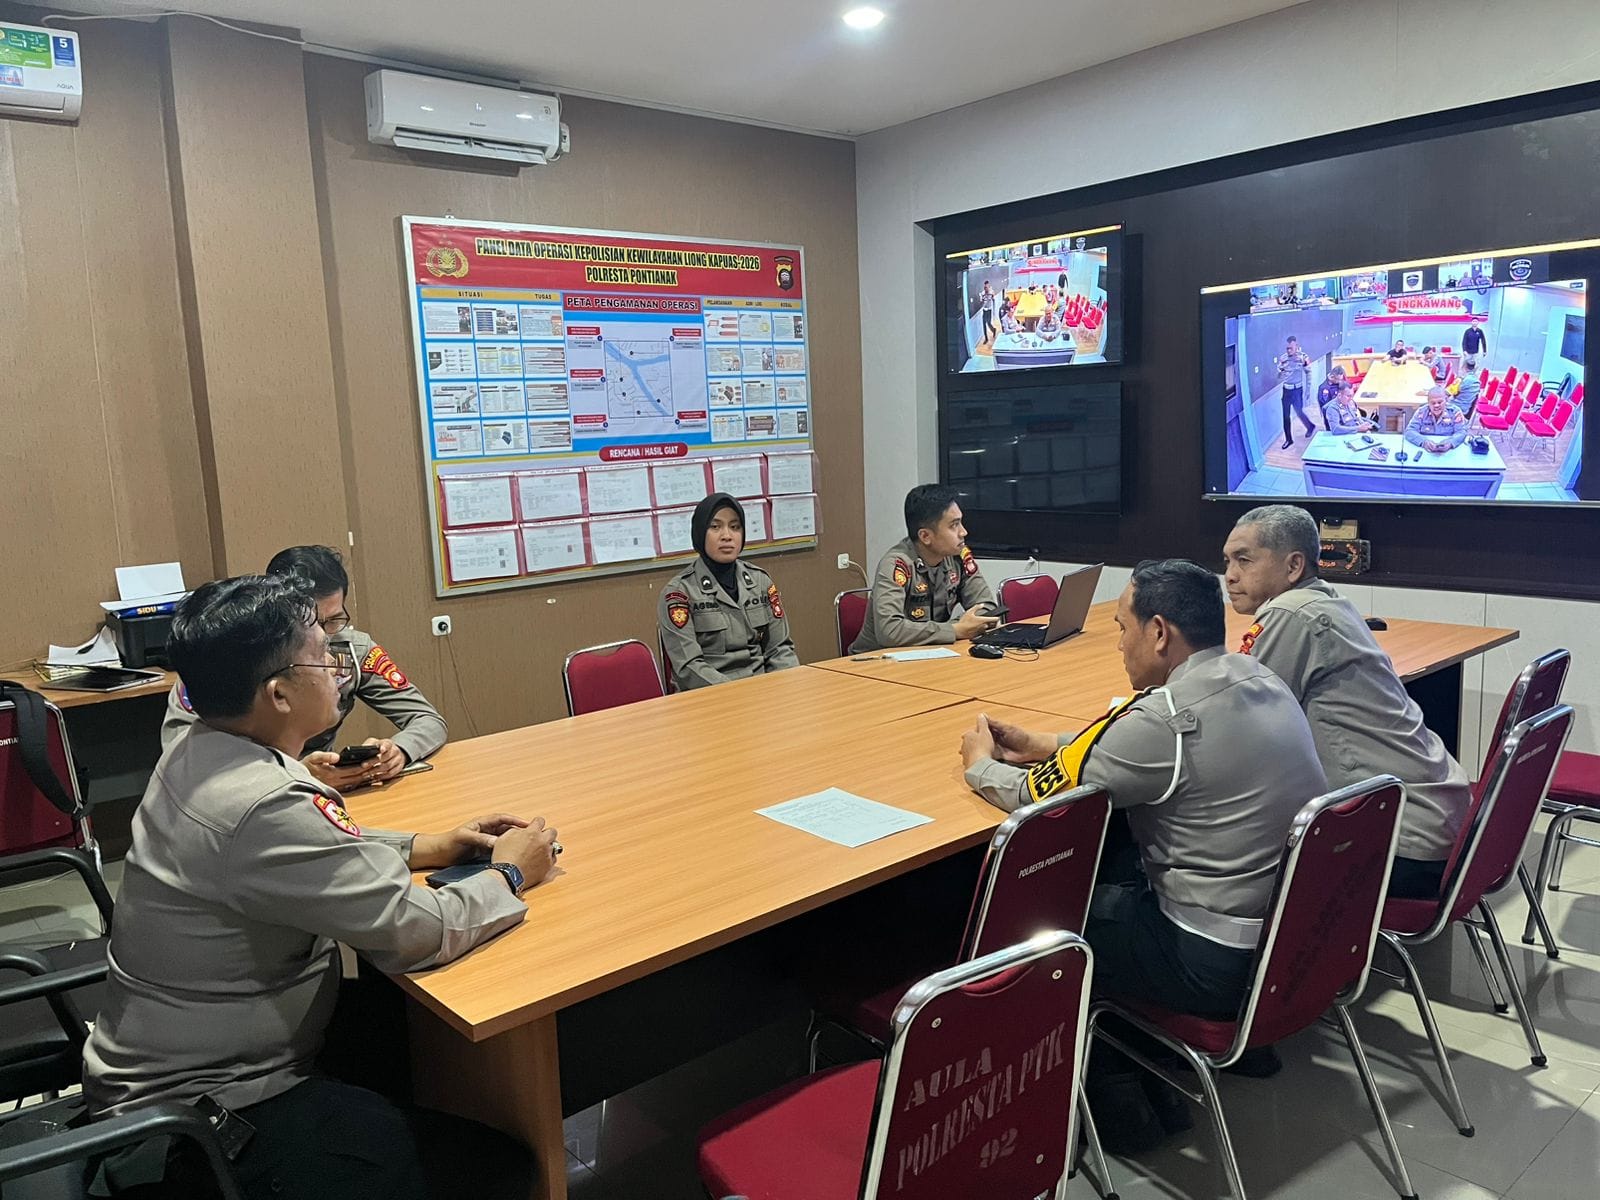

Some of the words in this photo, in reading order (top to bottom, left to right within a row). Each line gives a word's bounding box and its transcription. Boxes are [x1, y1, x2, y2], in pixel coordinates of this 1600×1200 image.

[60, 38, 68, 48] 5
[475, 238, 507, 255] PANEL
[508, 240, 532, 257] DATA
[534, 242, 574, 260] OPERASI
[574, 245, 624, 262] KEPOLISIAN
[626, 247, 683, 266] KEWILAYAHAN
[684, 251, 707, 268] LIONG
[708, 253, 761, 271] KAPUAS-2026
[586, 266, 629, 284] POLRESTA
[631, 269, 677, 286] PONTIANAK
[567, 297, 592, 307] PETA
[594, 298, 659, 309] PENGAMANAN
[661, 300, 698, 310] OPERASI
[1387, 299, 1462, 313] SINGKAWANG
[609, 448, 641, 458] RENCANA
[645, 446, 663, 456] HASIL
[664, 445, 679, 455] GIAT
[137, 606, 157, 615] SIDU
[1018, 860, 1045, 879] POLRESTA
[1044, 848, 1074, 867] PONTIANAK
[903, 1047, 992, 1112] AULA
[896, 1064, 1013, 1192] POLRESTA
[1018, 1022, 1066, 1096] PTK
[979, 1127, 1018, 1168] 92
